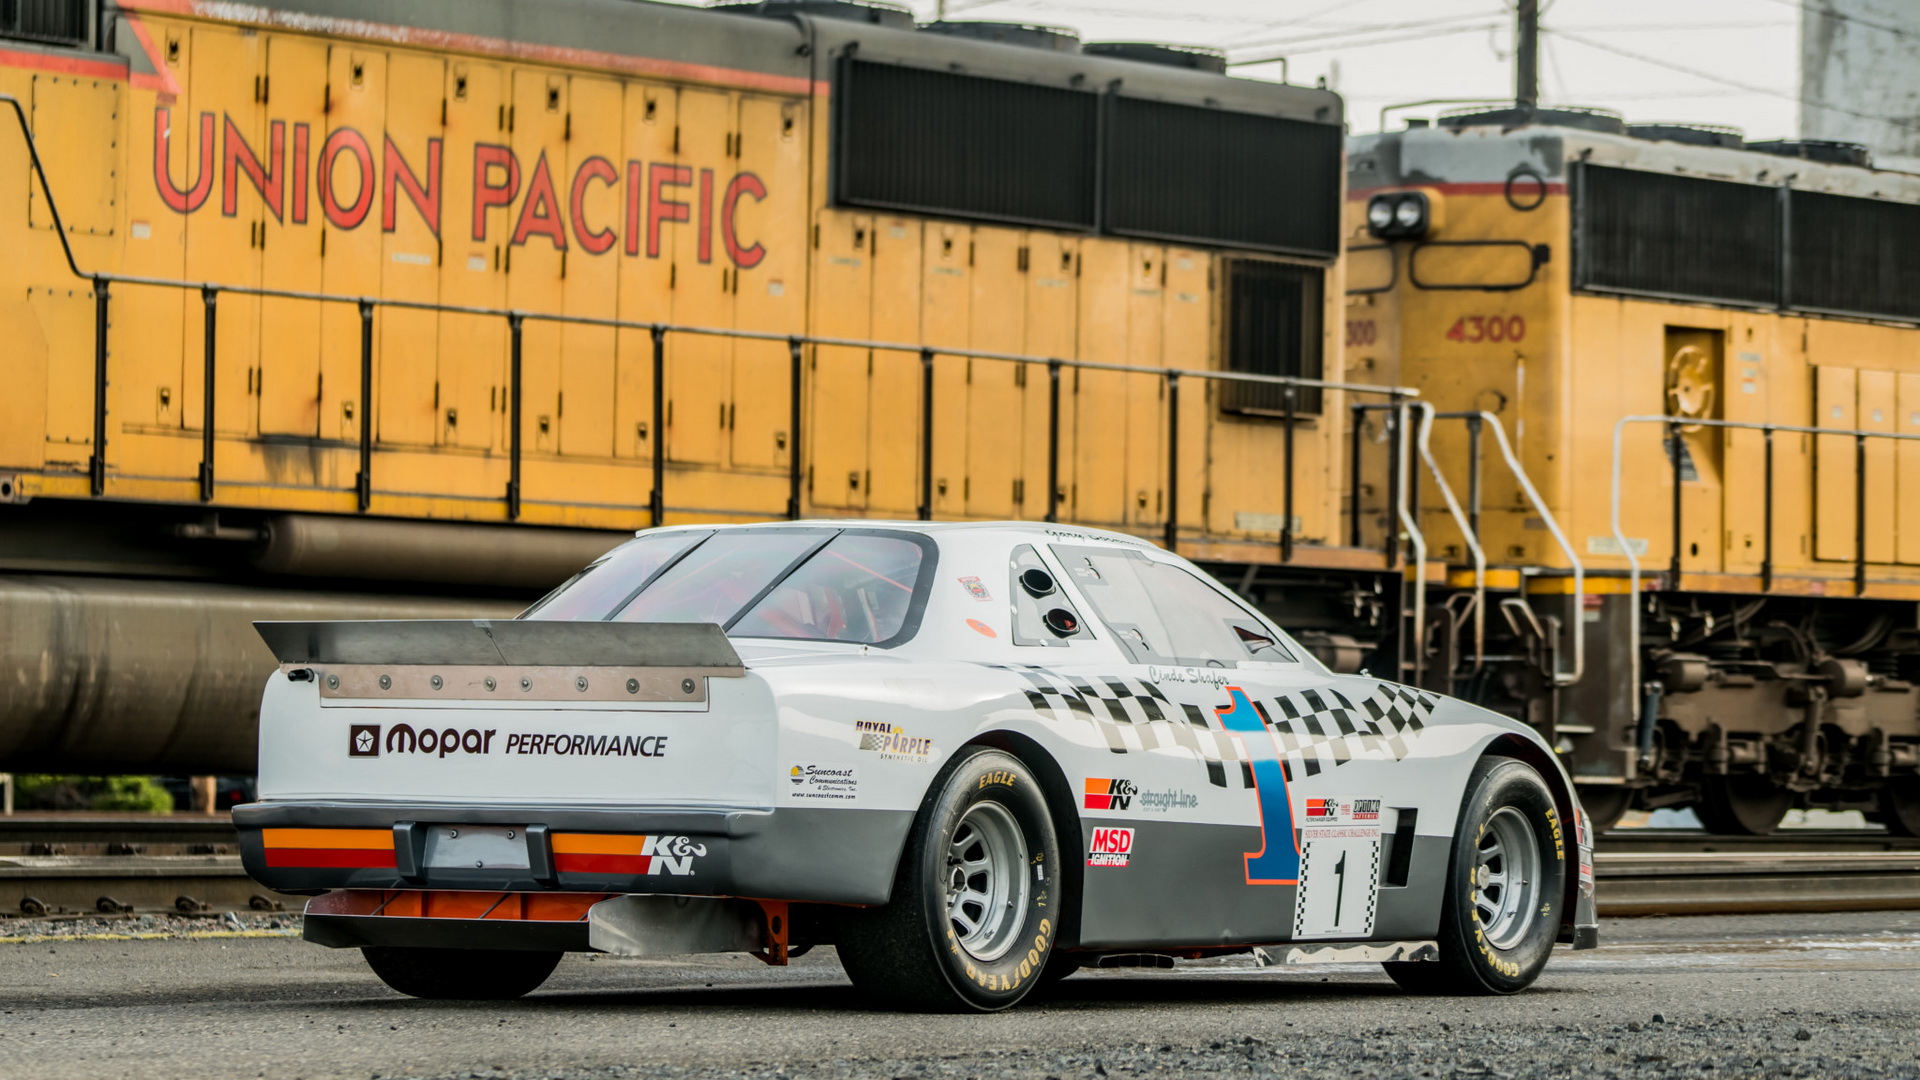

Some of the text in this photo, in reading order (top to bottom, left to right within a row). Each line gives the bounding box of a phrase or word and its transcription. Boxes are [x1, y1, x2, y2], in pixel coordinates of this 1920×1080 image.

[153, 105, 768, 270] UNION PACIFIC
[1446, 315, 1526, 343] 4300
[855, 720, 892, 734] ROYAL
[505, 733, 668, 757] PERFORMANCE
[805, 764, 853, 777] Suncoast
[809, 775, 857, 785] Communications
[979, 771, 1017, 789] EAGLE
[1213, 686, 1301, 885] 1
[1092, 829, 1132, 854] MSD
[1544, 808, 1565, 860] EAGLE
[1090, 854, 1128, 866] IGNITION
[1334, 850, 1346, 927] 1
[1470, 867, 1519, 977] GOODYEAR
[965, 918, 1051, 991] GOODYEAR
